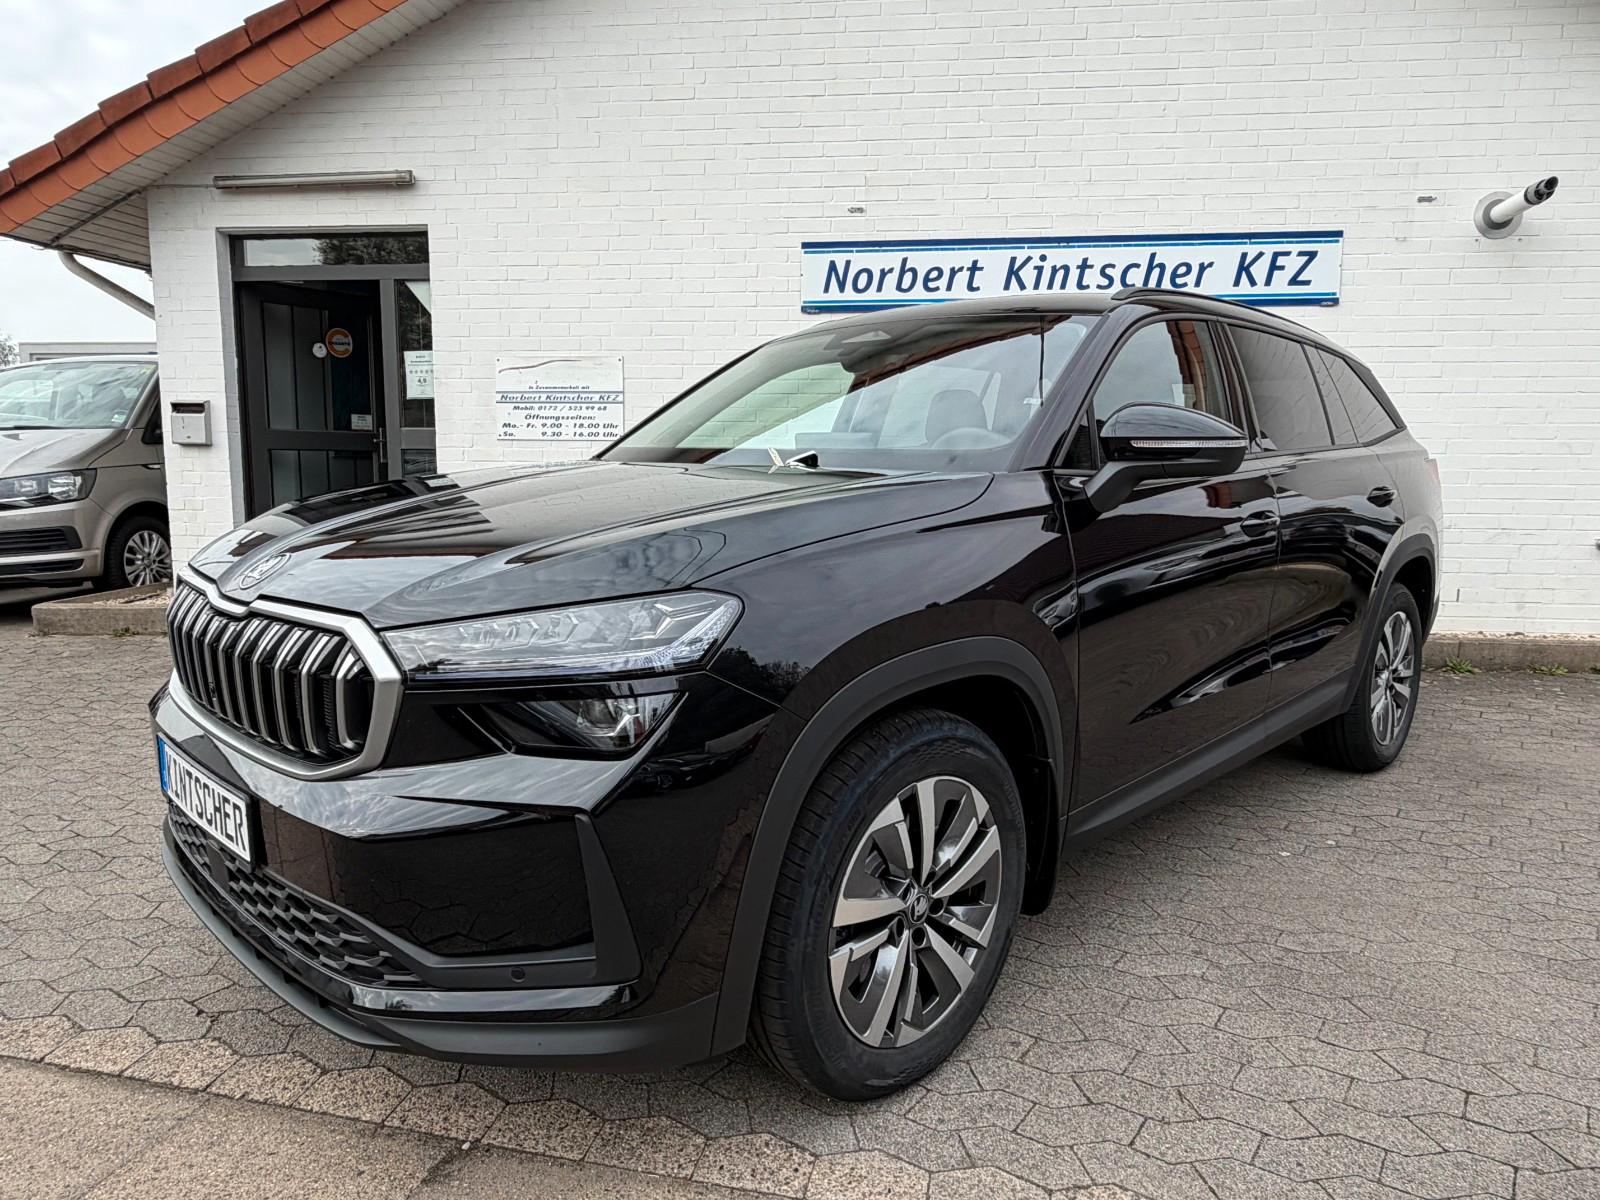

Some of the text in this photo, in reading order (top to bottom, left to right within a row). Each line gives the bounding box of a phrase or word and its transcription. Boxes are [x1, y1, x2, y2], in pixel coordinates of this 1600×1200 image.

[823, 250, 1319, 294] Norbert Kintscher KFZ
[524, 413, 597, 421] Öffnungszeiten:
[166, 751, 247, 853] KINTSCHER
